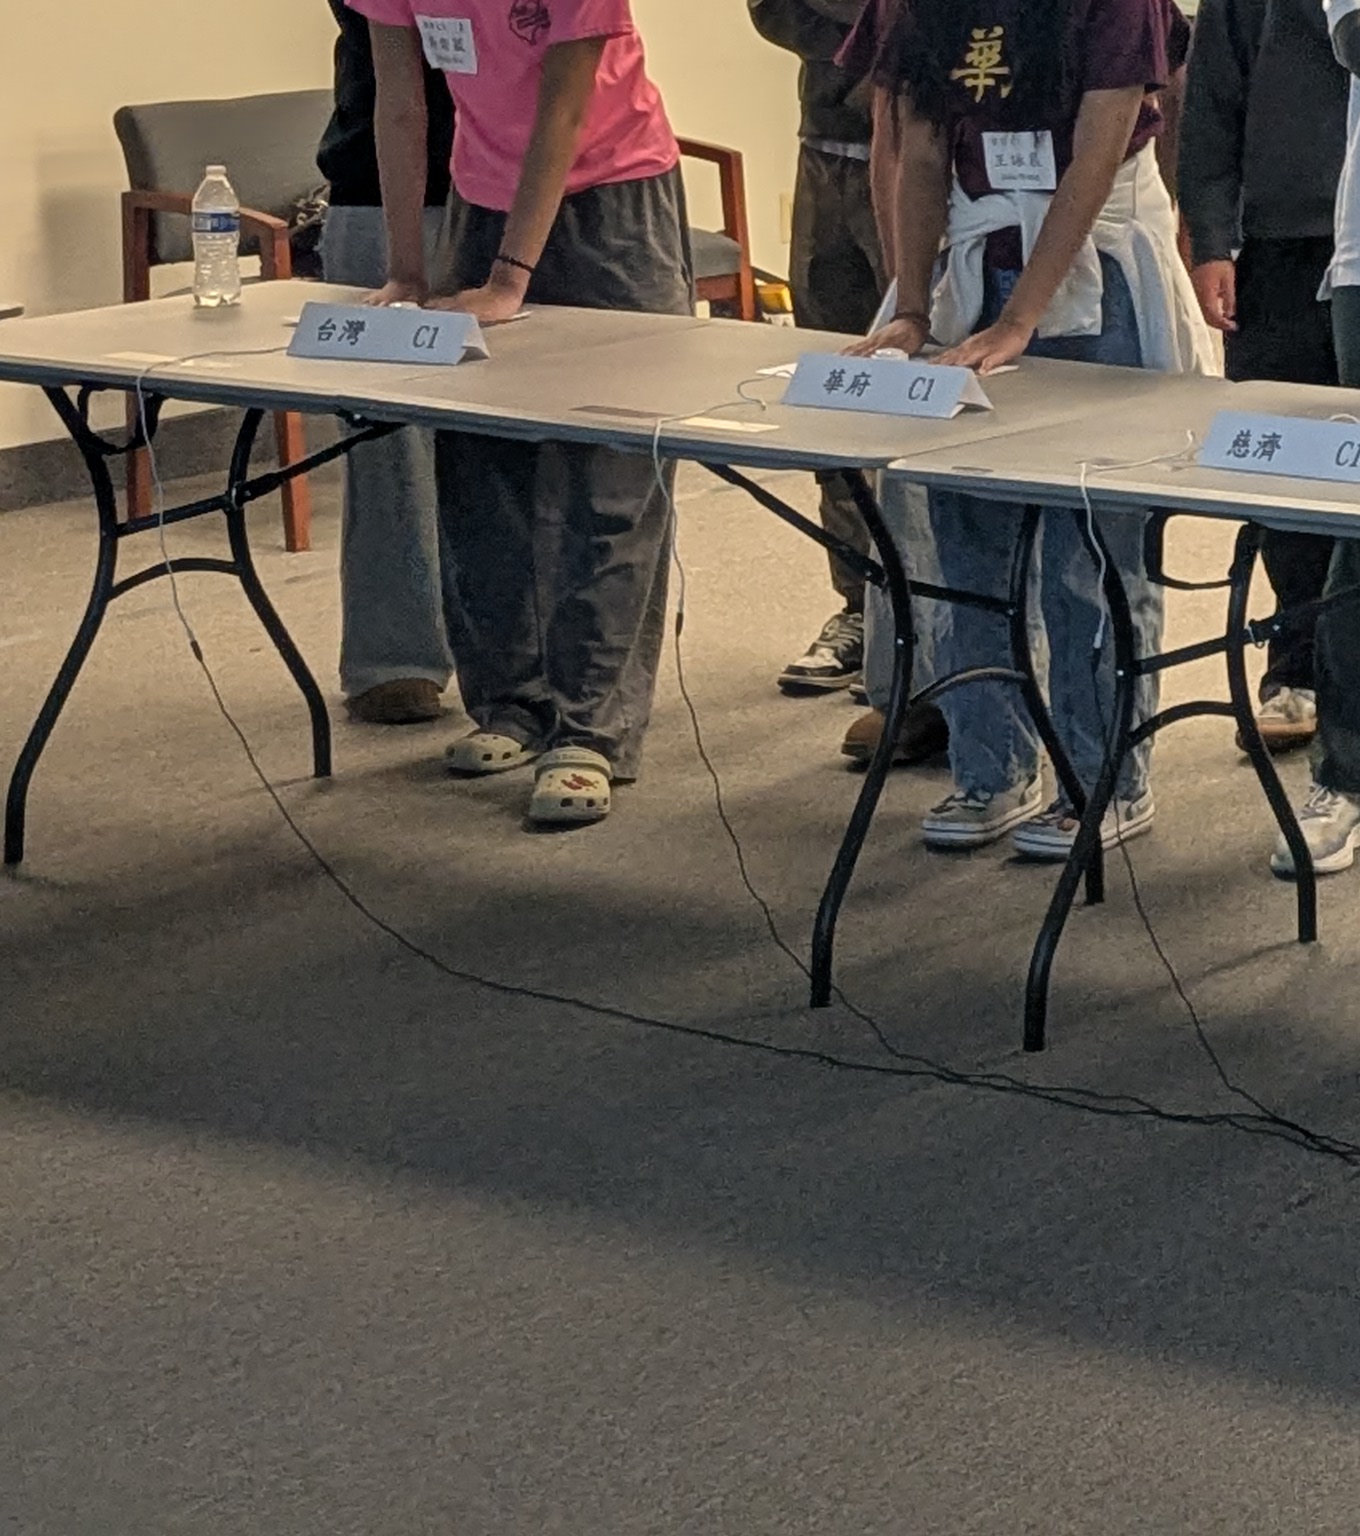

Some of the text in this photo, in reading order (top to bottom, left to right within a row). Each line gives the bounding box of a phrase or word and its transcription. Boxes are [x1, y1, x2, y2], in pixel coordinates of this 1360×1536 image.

[951, 26, 1009, 103] 華
[316, 317, 440, 349] 台灣 C1
[822, 368, 936, 402] 華府 C1
[1226, 429, 1283, 462] 慈濟
